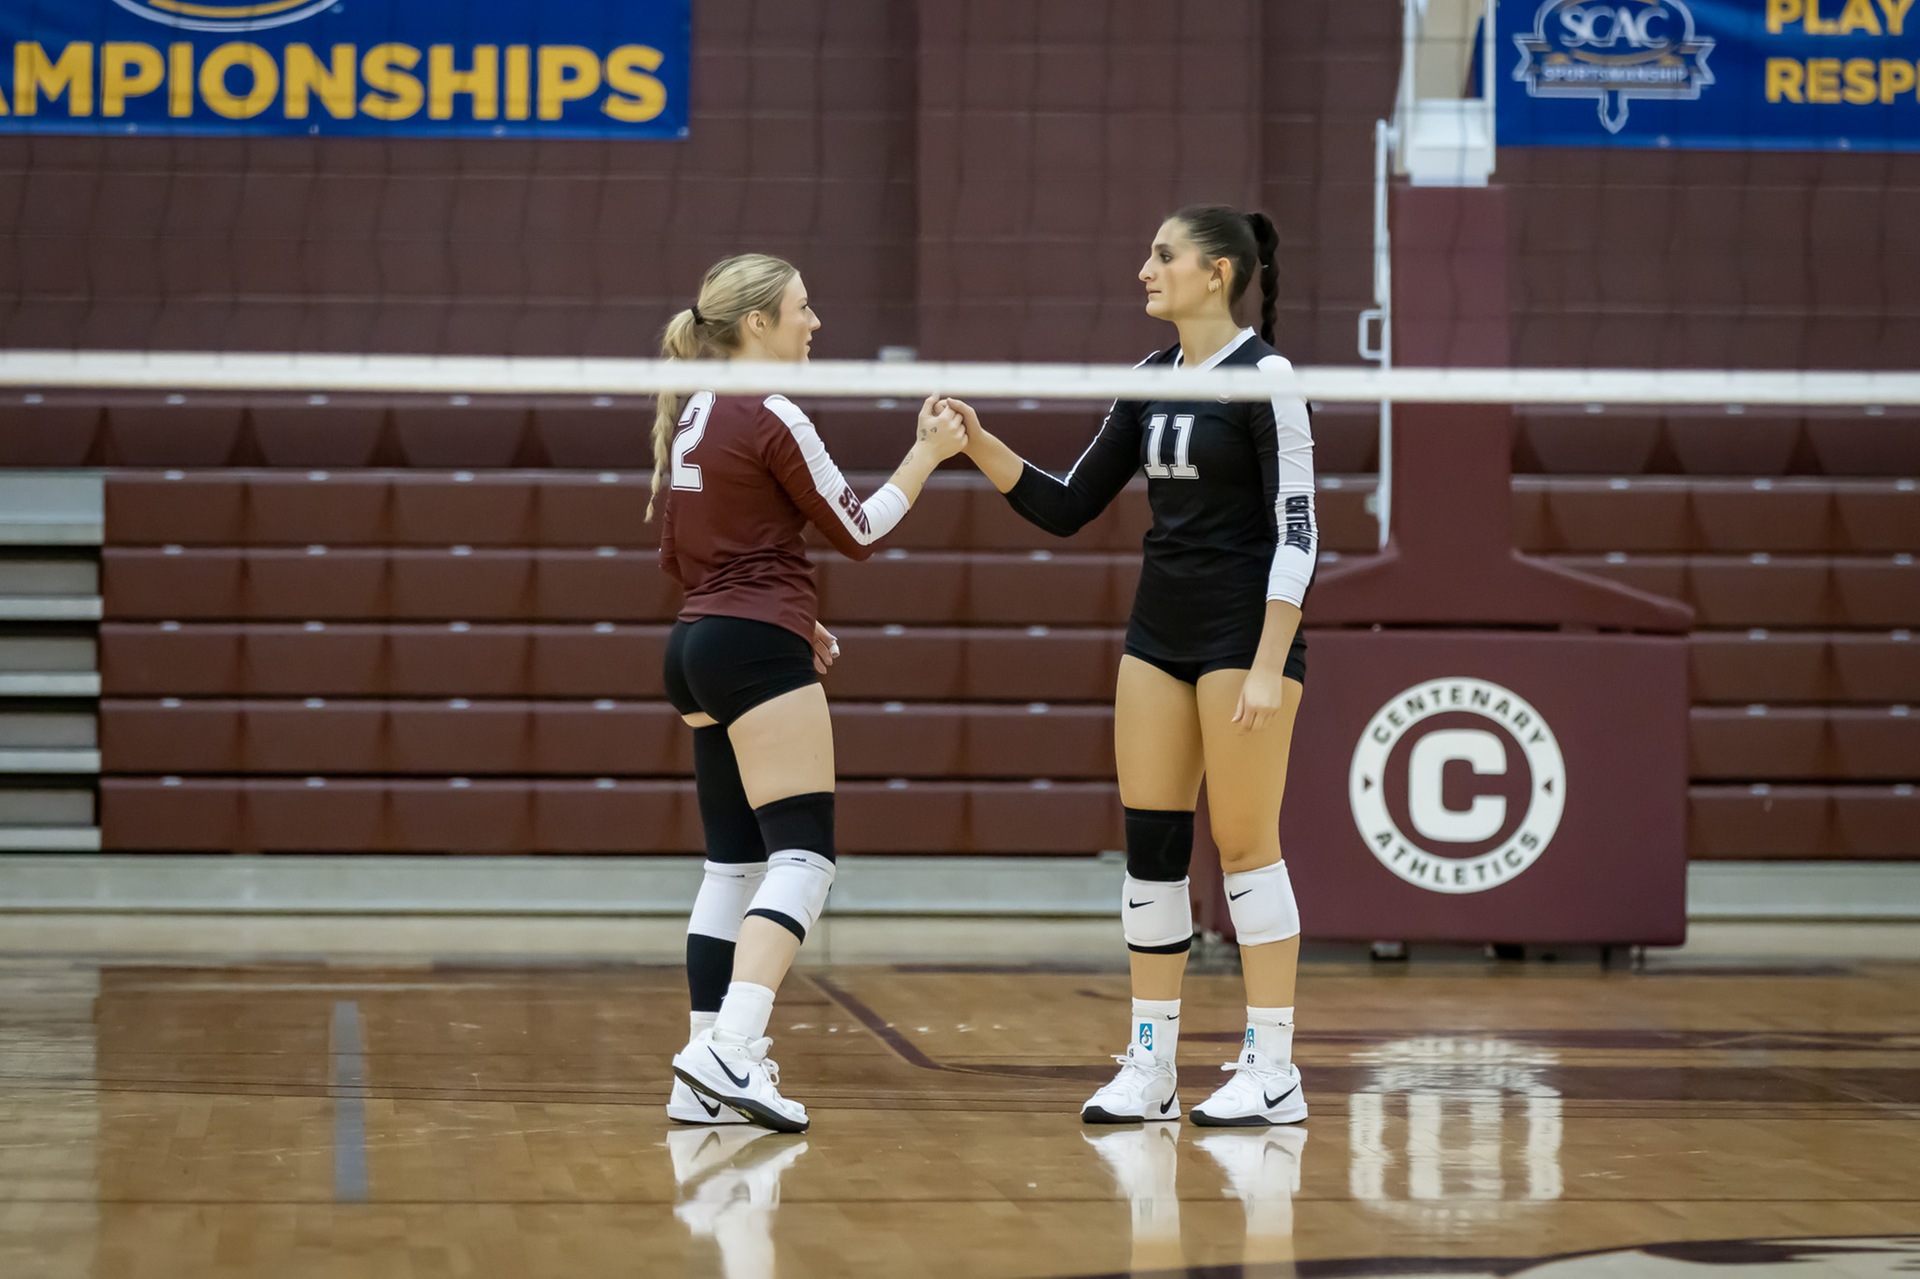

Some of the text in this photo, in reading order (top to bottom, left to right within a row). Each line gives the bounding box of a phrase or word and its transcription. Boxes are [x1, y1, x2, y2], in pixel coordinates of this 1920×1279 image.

[1559, 4, 1670, 49] SCAC
[1766, 0, 1915, 36] PLAY
[0, 42, 668, 123] MPIONSHIPS
[1766, 58, 1920, 105] RESP
[671, 389, 716, 492] 2
[1143, 414, 1199, 479] 11
[1371, 686, 1545, 745] CENTENARY
[1408, 728, 1507, 843] C
[1373, 831, 1540, 886] ATHLETICS
